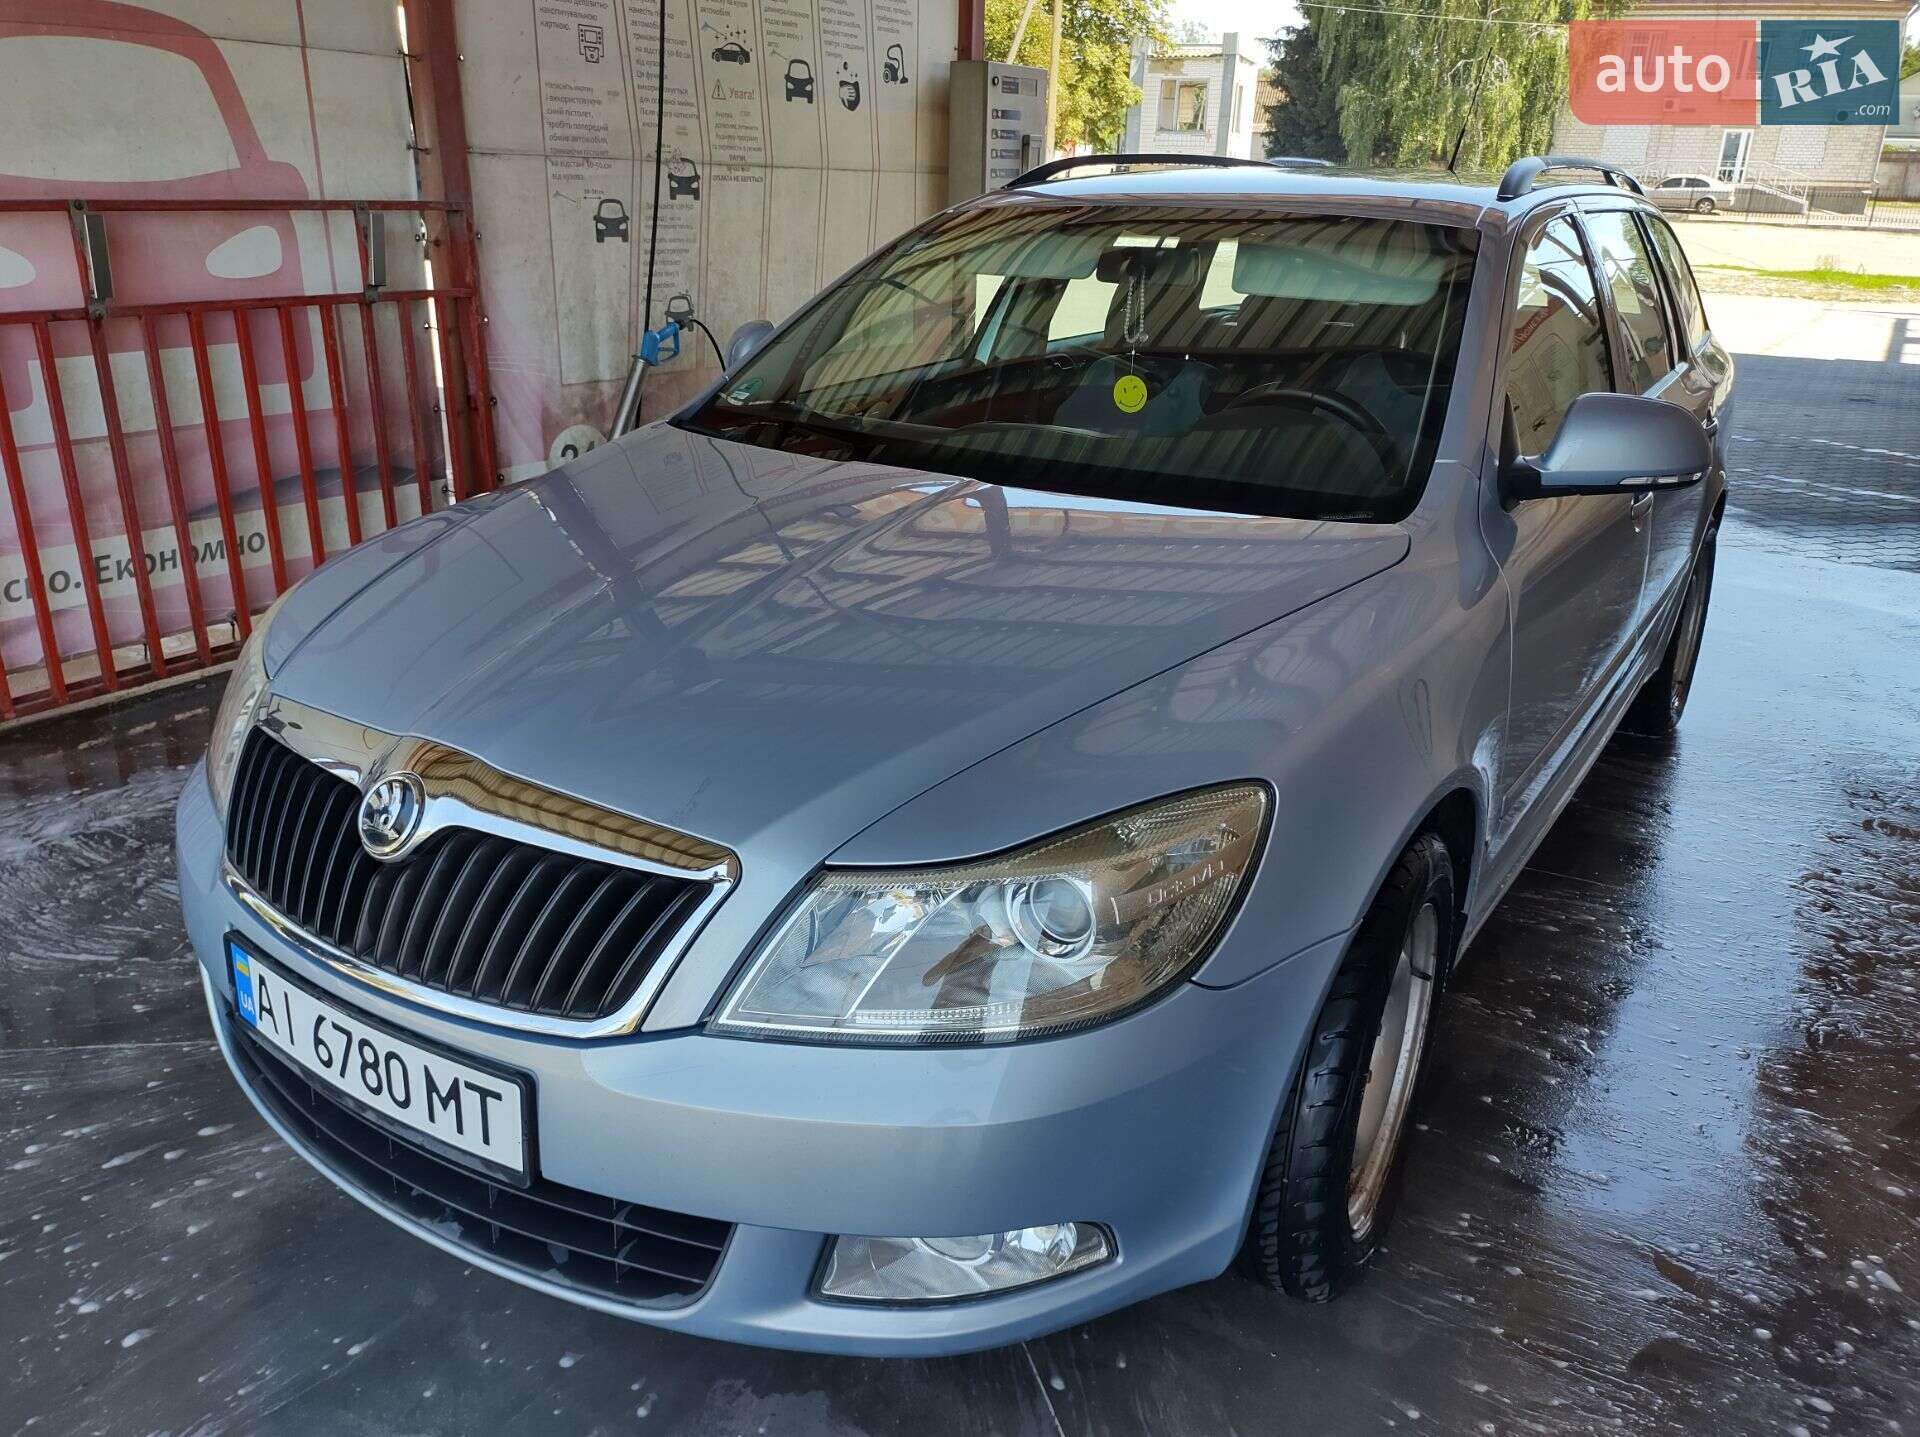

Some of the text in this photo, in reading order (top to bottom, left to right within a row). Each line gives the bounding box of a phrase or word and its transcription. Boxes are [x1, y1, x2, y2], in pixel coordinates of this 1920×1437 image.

[729, 87, 755, 101] Увага!
[240, 990, 256, 1016] UA
[258, 973, 504, 1147] AI 6780 MT
